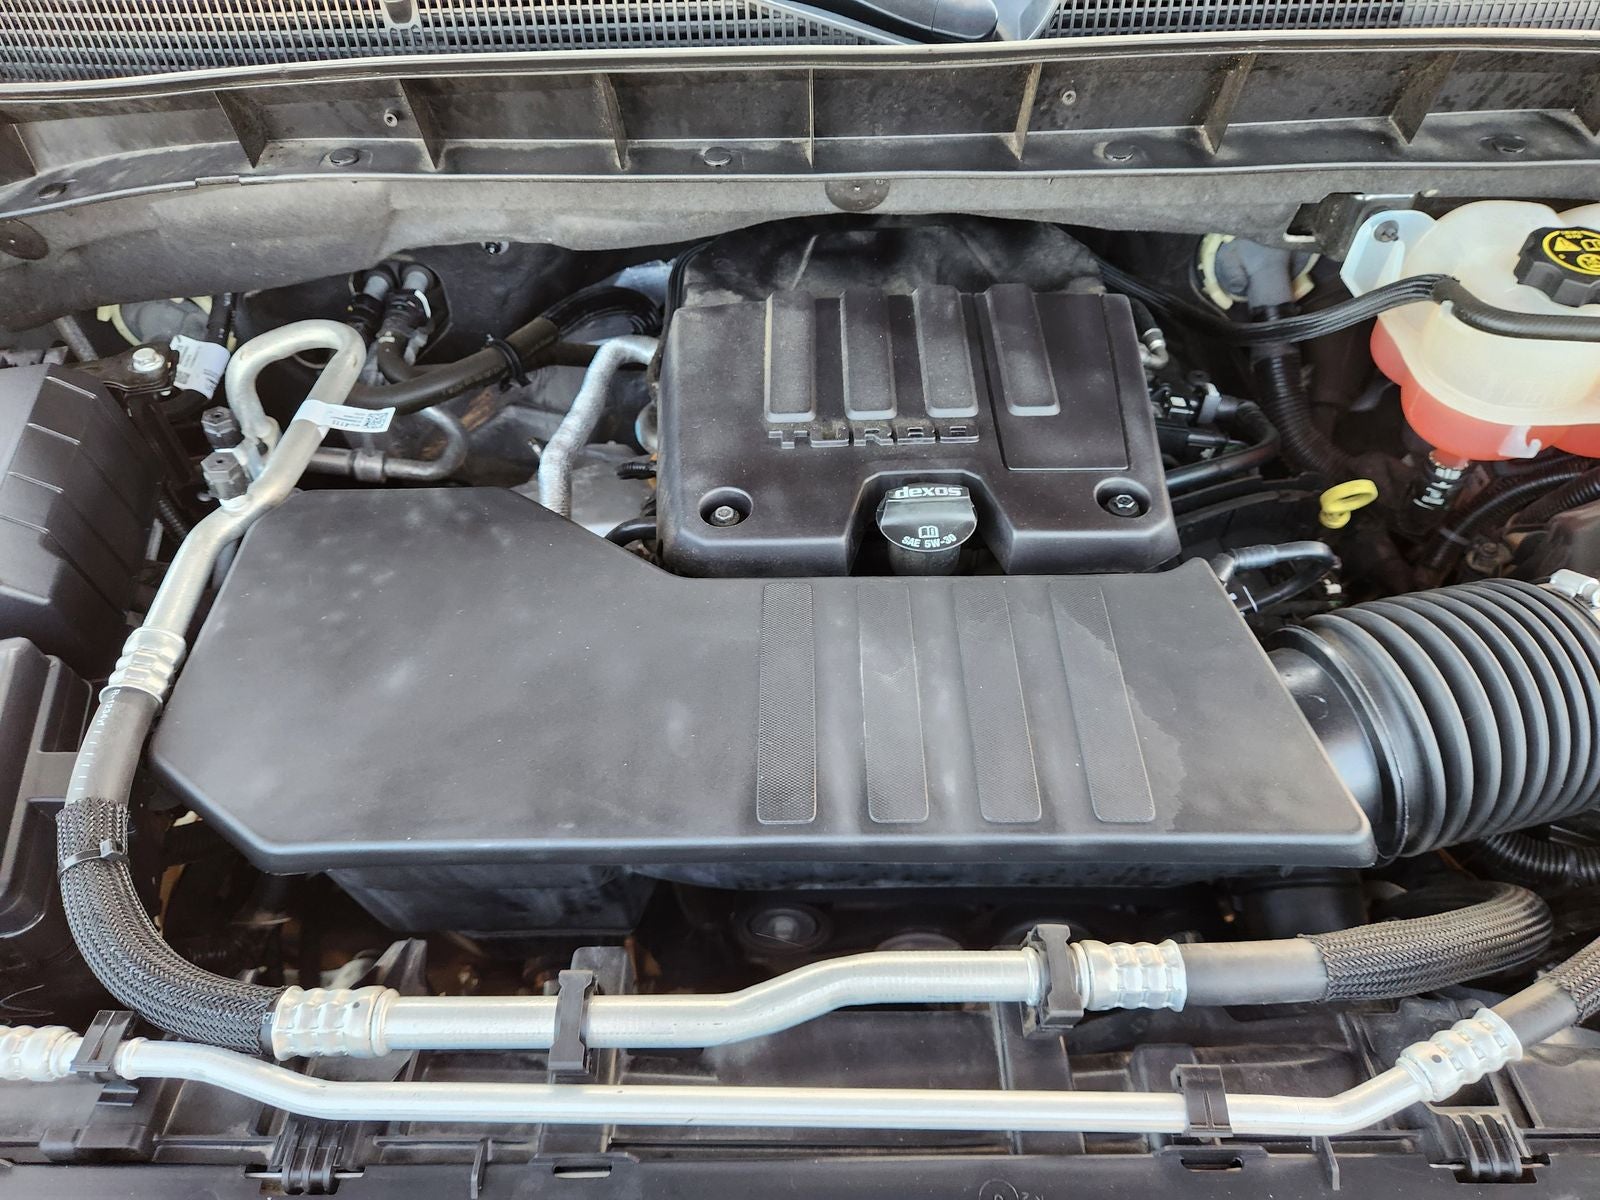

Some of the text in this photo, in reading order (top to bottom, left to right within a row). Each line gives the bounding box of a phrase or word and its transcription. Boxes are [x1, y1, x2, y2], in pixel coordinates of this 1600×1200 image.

[767, 421, 980, 449] TURBO
[894, 486, 963, 499] dexos
[901, 534, 957, 548] SAE 5W-30
